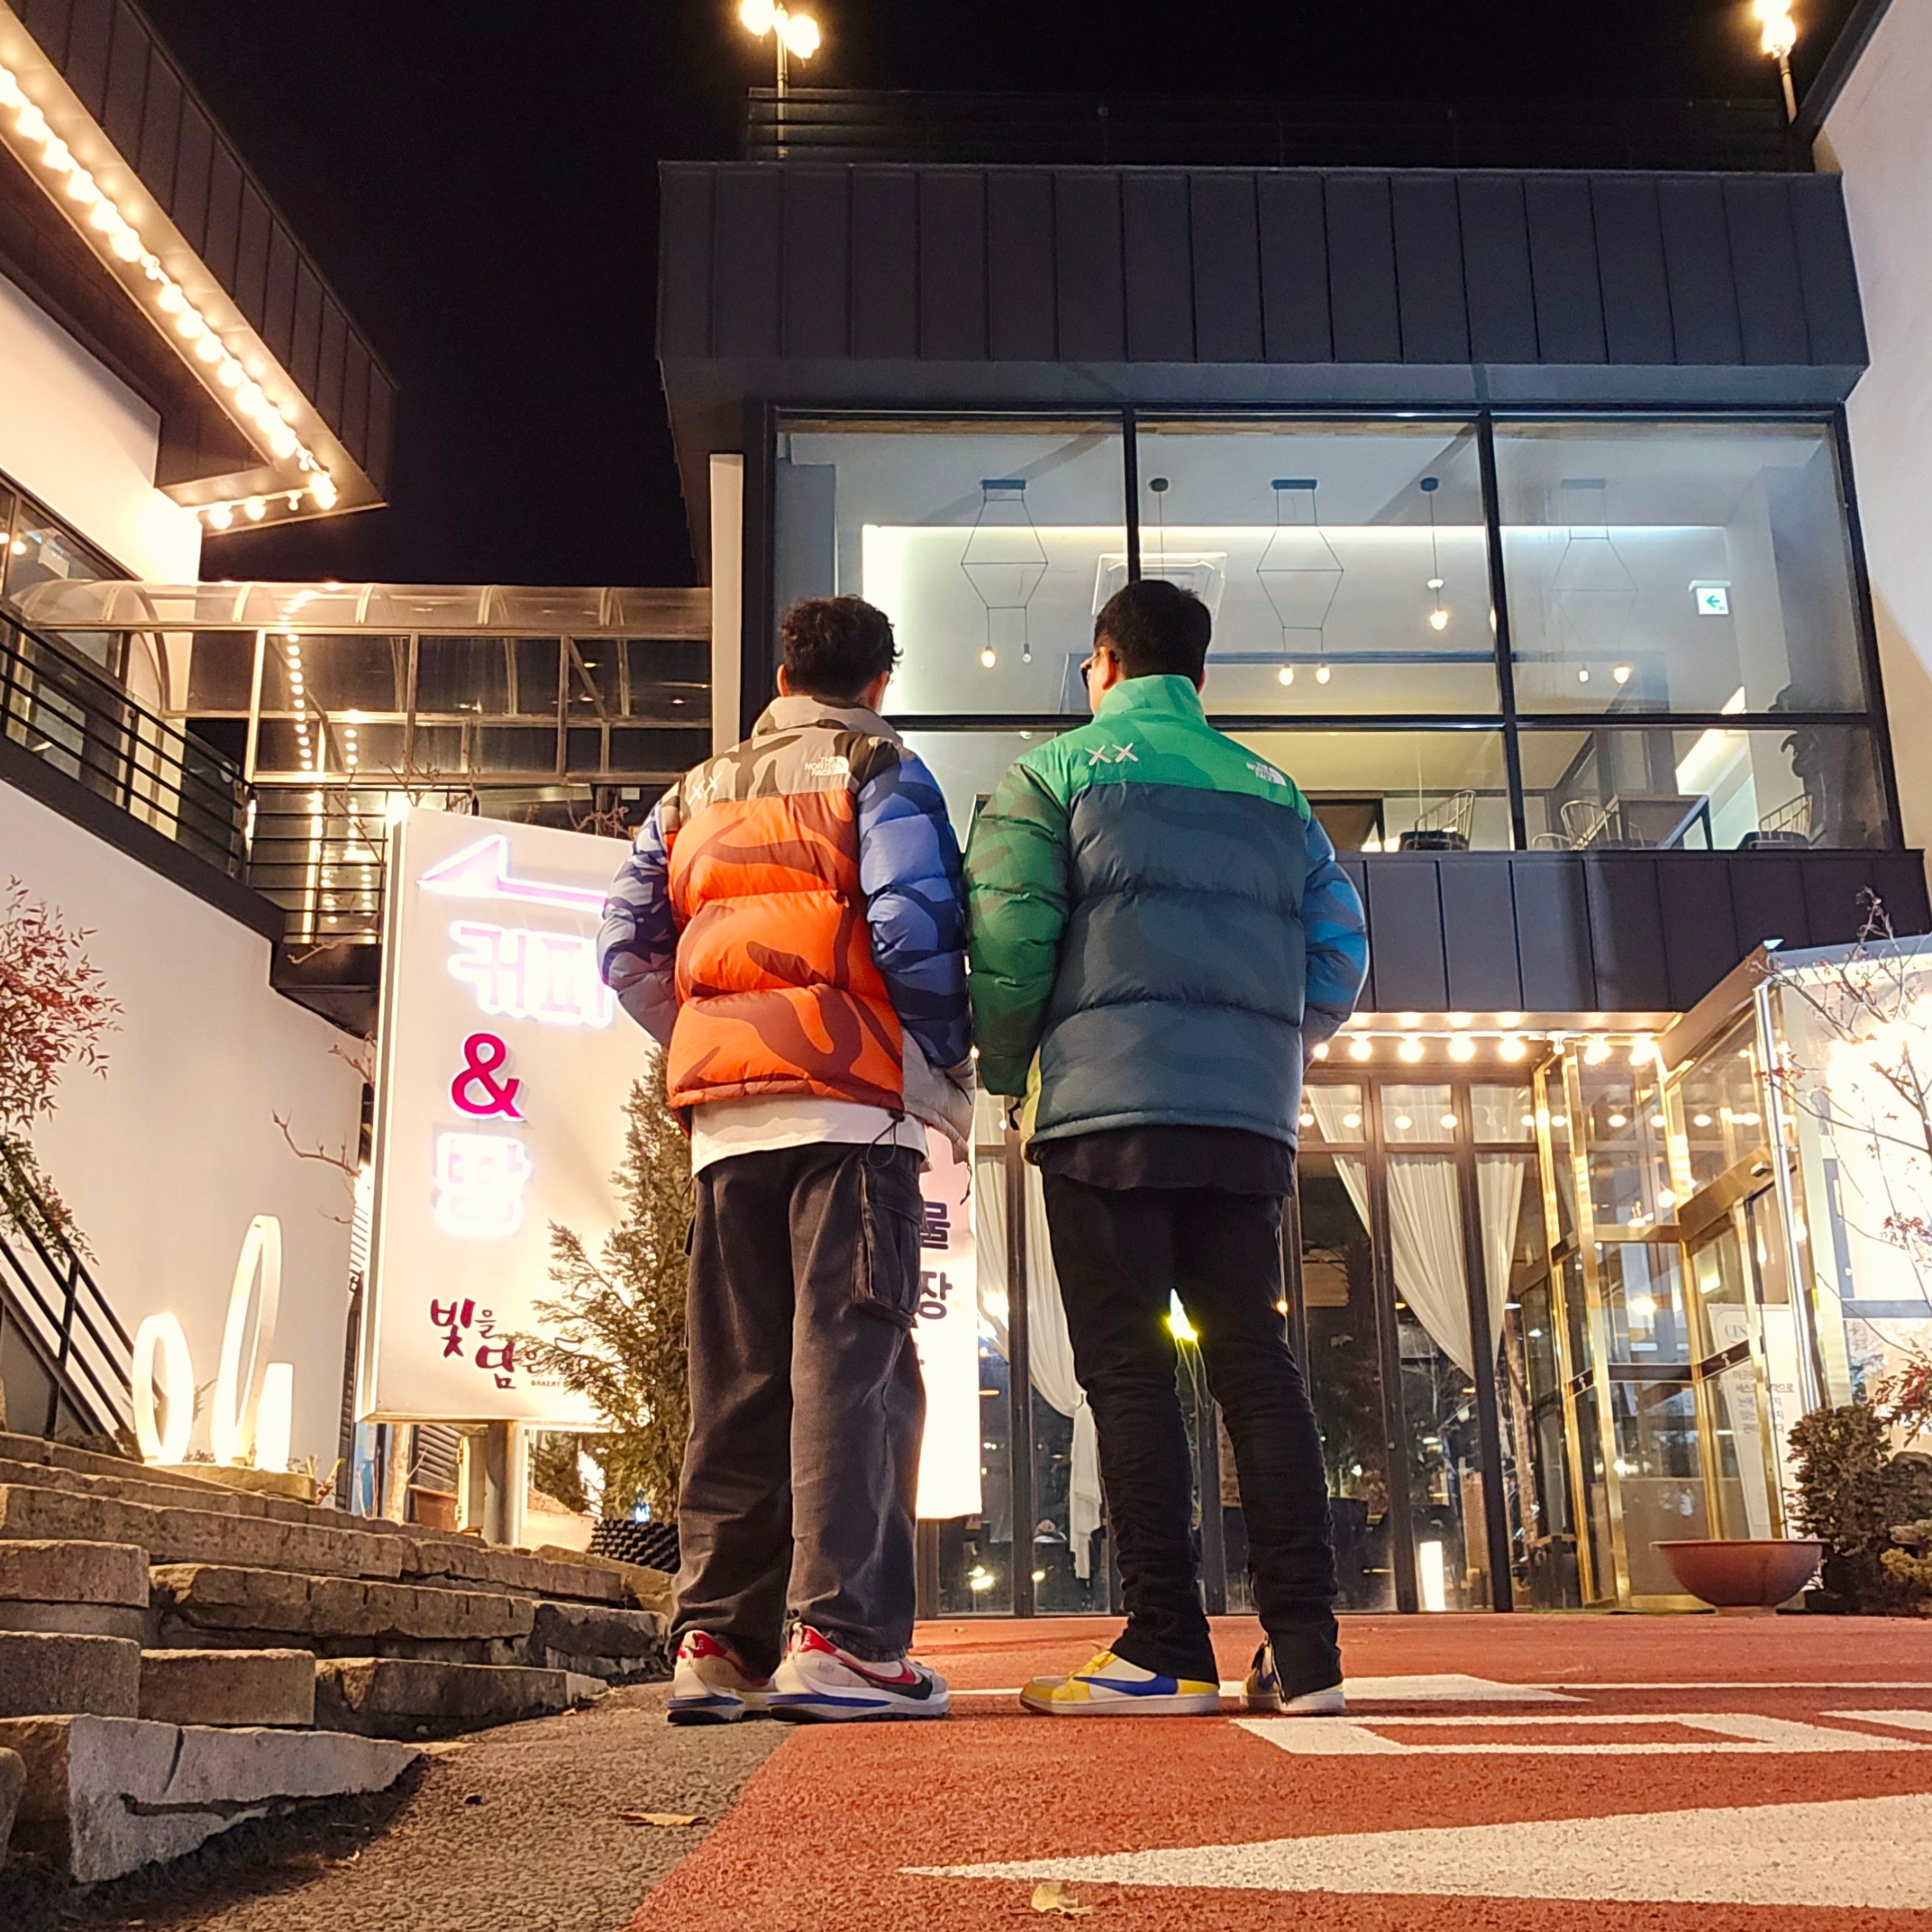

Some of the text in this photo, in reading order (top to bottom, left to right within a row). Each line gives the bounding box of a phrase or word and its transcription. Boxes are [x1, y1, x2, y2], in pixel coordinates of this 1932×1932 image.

[804, 762, 836, 771] NORTH
[820, 756, 836, 764] THE
[450, 1031, 524, 1120] &
[430, 1297, 496, 1359] 빛을
[475, 1339, 543, 1389] 담은
